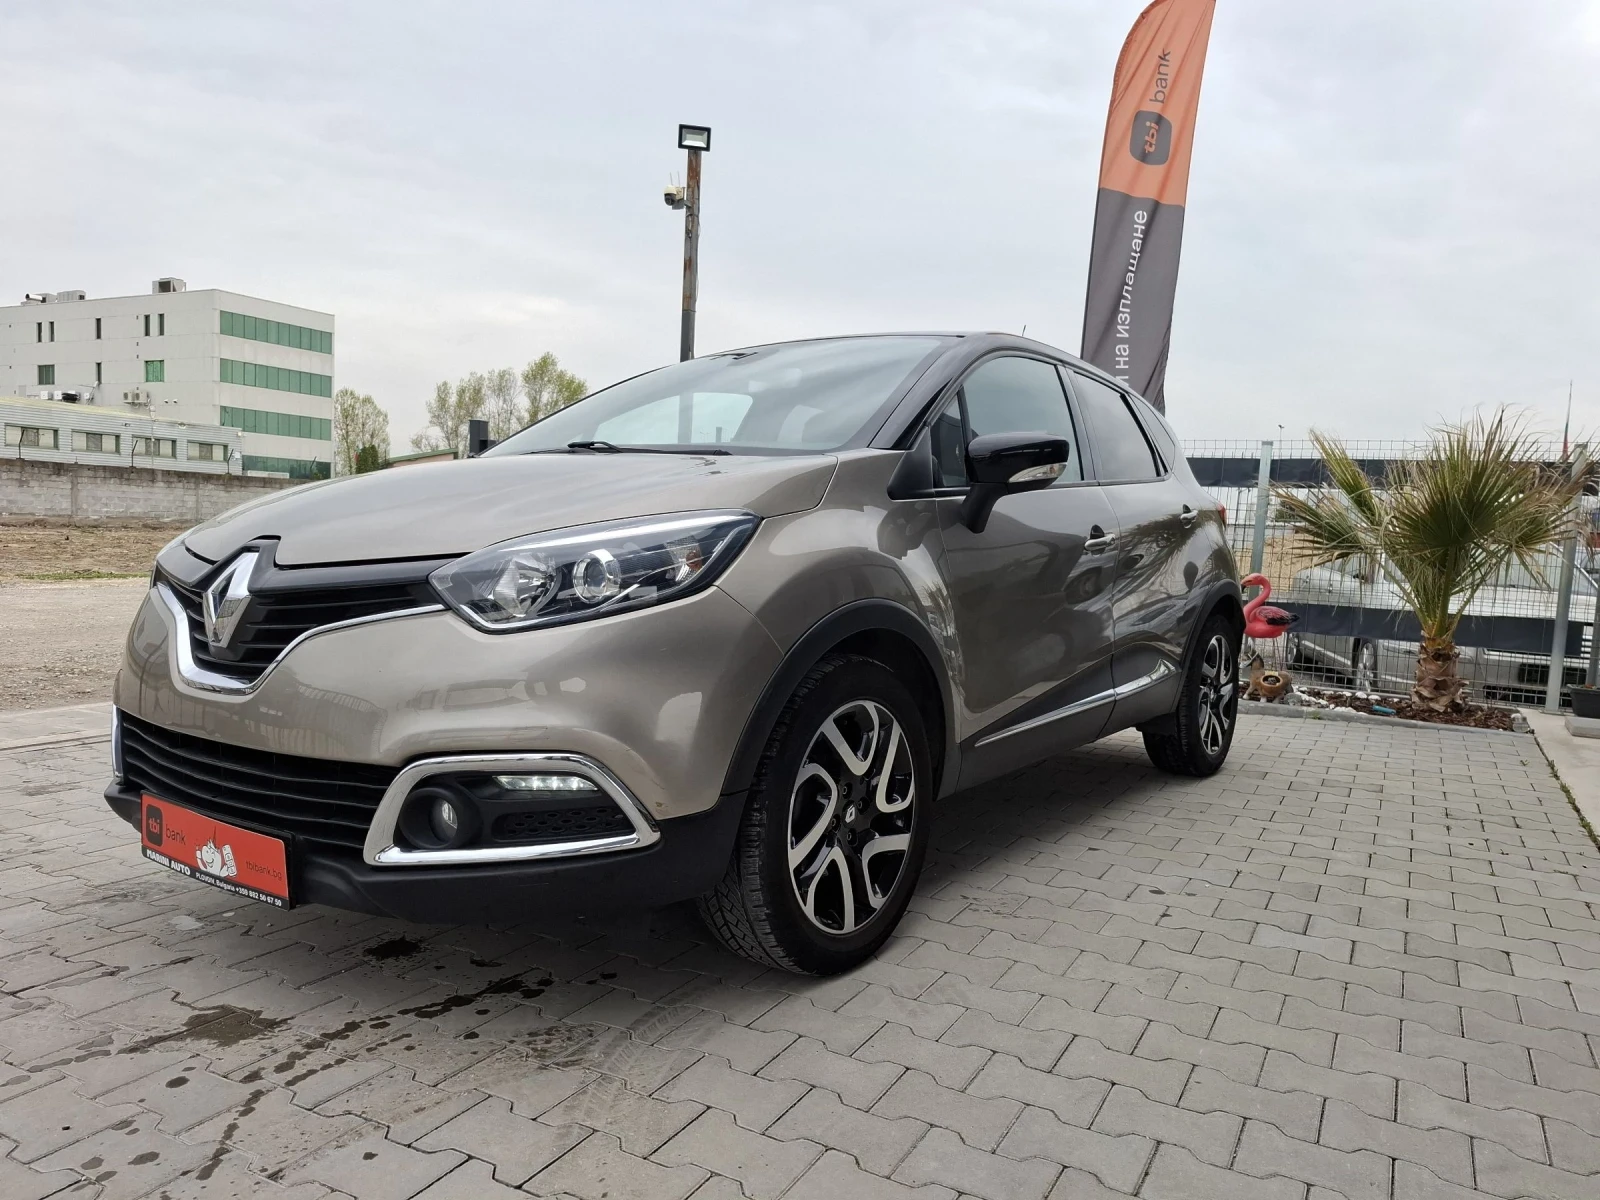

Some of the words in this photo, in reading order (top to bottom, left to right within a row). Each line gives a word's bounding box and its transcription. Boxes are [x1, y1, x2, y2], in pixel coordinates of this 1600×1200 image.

[1149, 48, 1171, 104] bank
[1143, 121, 1160, 154] tbi
[1116, 210, 1148, 338] изплащане
[1115, 344, 1129, 369] на
[148, 817, 160, 835] tbi
[165, 823, 186, 845] bank
[170, 860, 191, 876] AUTO
[245, 860, 282, 881] tbibank.bg
